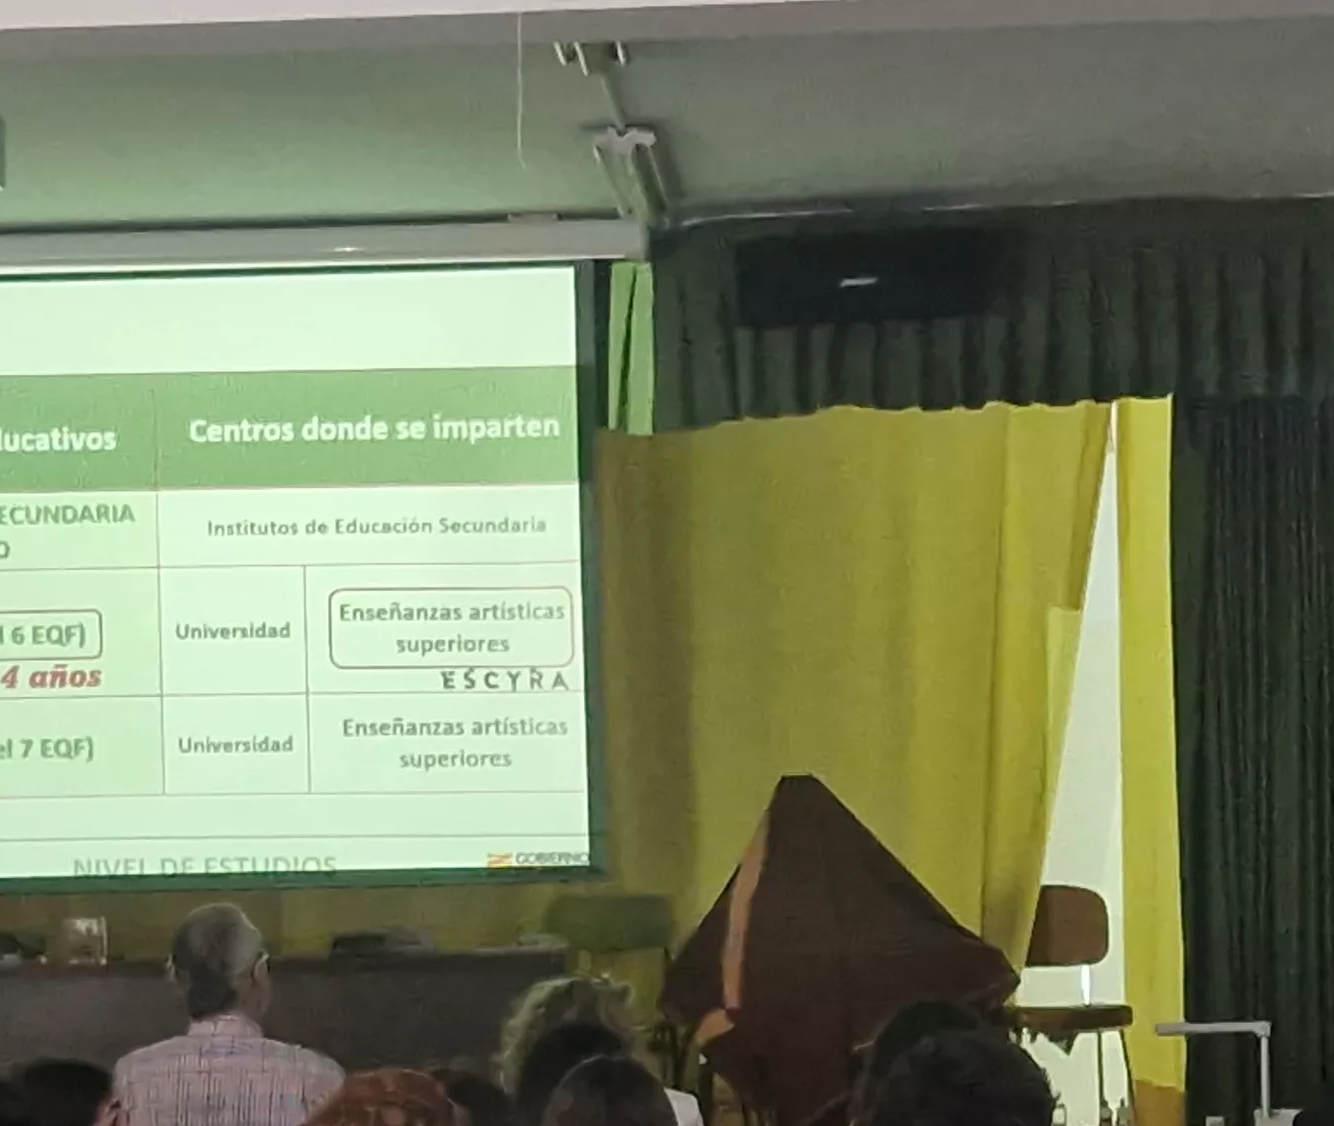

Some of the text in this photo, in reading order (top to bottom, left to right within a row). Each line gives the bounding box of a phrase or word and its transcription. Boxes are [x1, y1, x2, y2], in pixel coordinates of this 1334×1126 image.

[189, 412, 560, 444] Centros donde se imparten
[207, 516, 547, 537] Institutos de Educación Secundaria
[339, 601, 565, 621] Enseñanzas artísticas
[11, 625, 25, 646] 6
[31, 622, 87, 649] EQF)
[176, 622, 291, 641] Universidad
[396, 634, 510, 657] superiores
[0, 664, 102, 688] 4 años
[343, 716, 568, 737] Enseñanzas artísticas
[20, 739, 34, 759] 7
[40, 736, 95, 763] EQF)
[178, 735, 294, 755] Universidad
[400, 750, 512, 772] superiores
